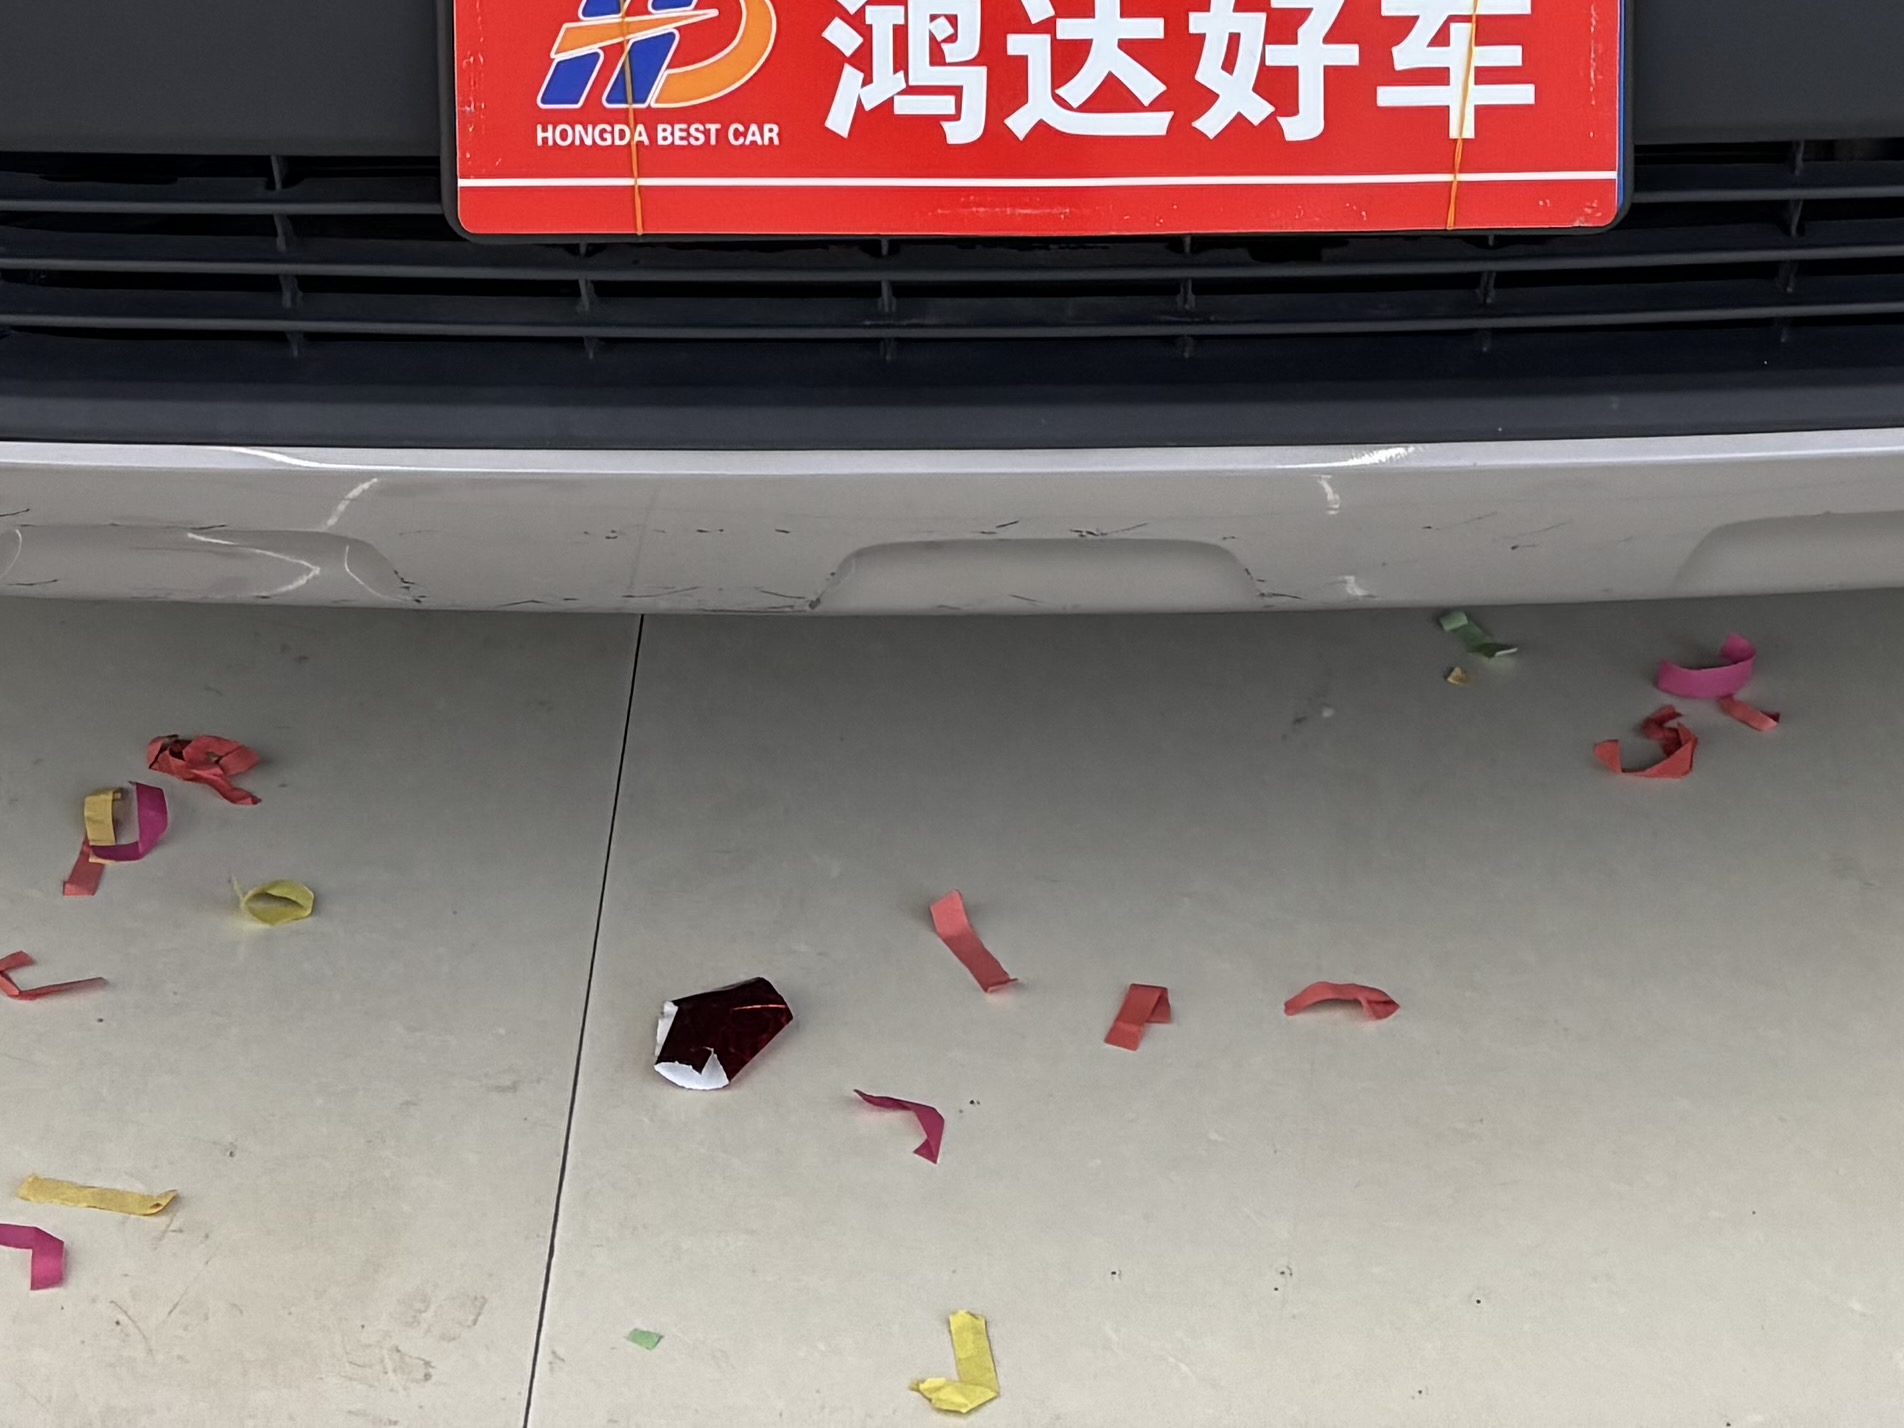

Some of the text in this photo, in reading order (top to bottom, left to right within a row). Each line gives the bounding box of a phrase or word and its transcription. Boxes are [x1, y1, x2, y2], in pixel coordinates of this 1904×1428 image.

[536, 123, 780, 147] HONGDA BEST CAR
